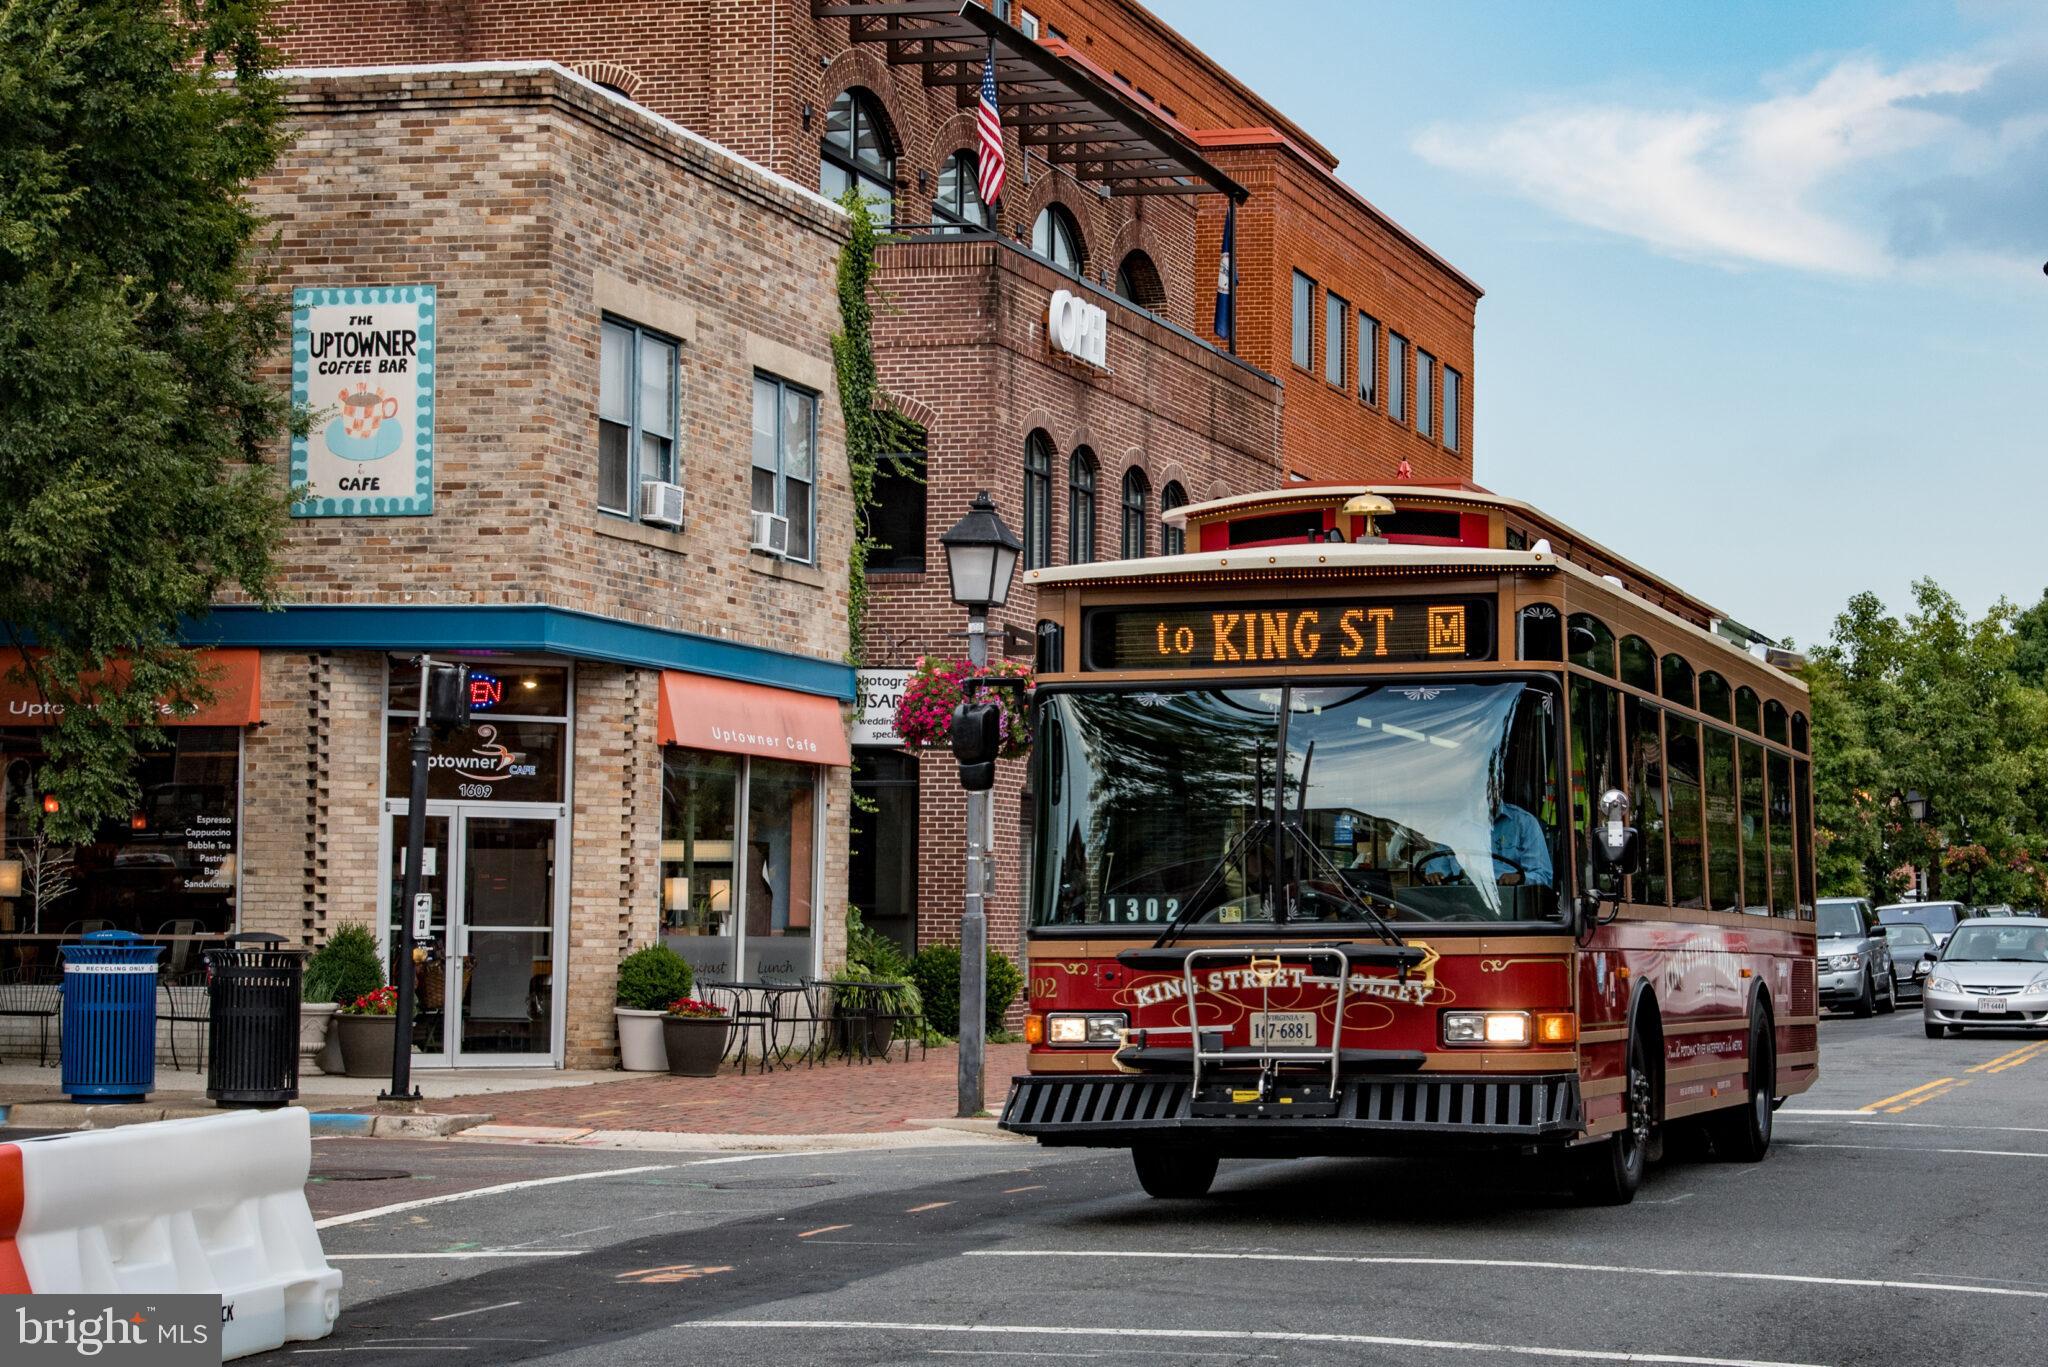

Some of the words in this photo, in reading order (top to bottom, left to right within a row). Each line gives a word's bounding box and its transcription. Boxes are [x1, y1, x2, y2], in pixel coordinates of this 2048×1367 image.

[349, 315, 373, 326] THE
[310, 329, 417, 359] UPTOWNER
[318, 359, 371, 375] COFFEE
[378, 358, 408, 374] BAR
[338, 477, 380, 491] CAFE
[1156, 622, 1194, 654] to
[1212, 610, 1321, 661] KING
[1340, 608, 1393, 656] ST
[711, 726, 779, 747] Uptowner
[786, 737, 817, 752] Cafe
[412, 754, 497, 771] ptowner
[509, 764, 536, 775] CAFE
[459, 784, 492, 797] 1609
[197, 815, 231, 825] Espresso
[185, 828, 231, 838] Cappuccino
[188, 841, 216, 850] Bubble
[1108, 898, 1179, 921] 1302
[757, 960, 794, 974] Lunch
[1134, 976, 1198, 1008] KING
[1208, 967, 1307, 993] STREET
[1315, 969, 1433, 1007] OLLEY
